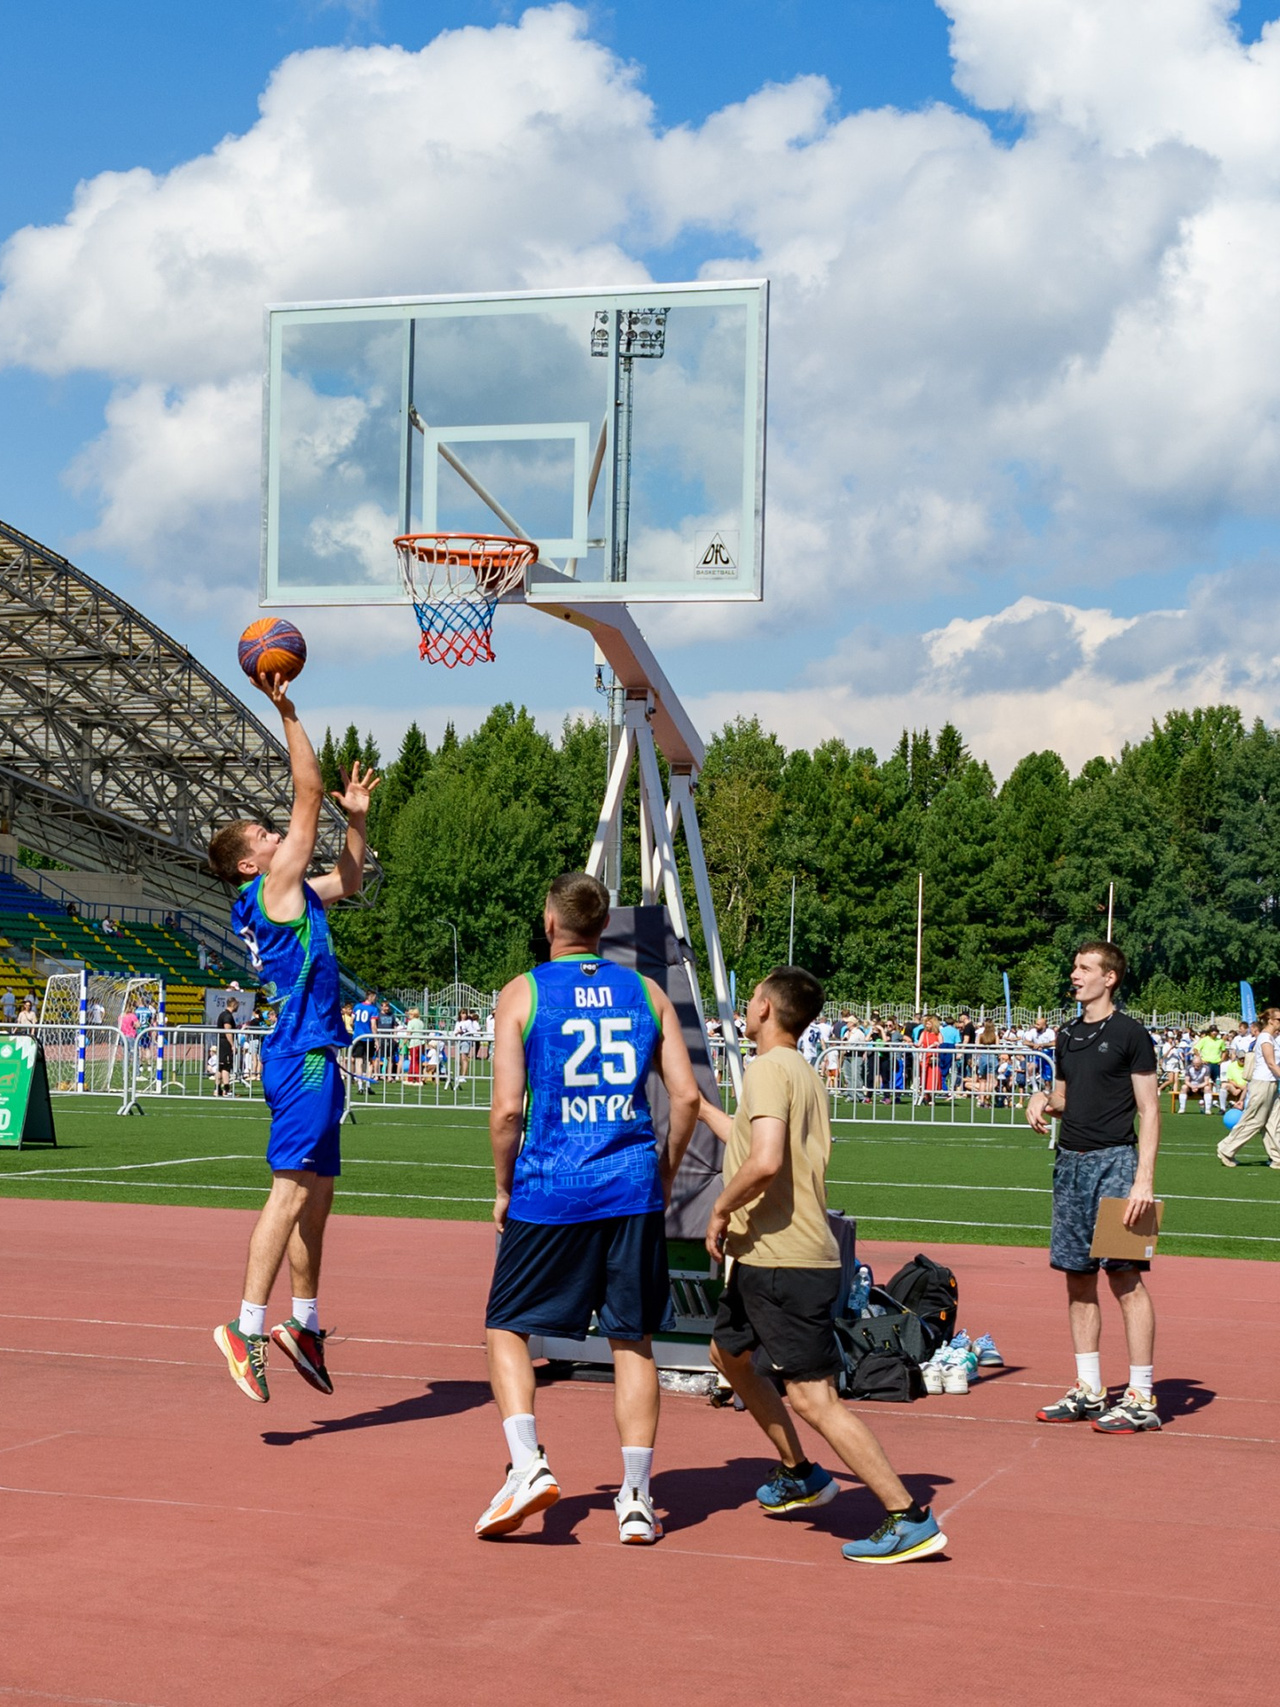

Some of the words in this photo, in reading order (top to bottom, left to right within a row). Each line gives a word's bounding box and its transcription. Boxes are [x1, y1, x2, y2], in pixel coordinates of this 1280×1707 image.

[702, 543, 730, 565] DFC
[574, 986, 613, 1008] ВАЛ
[355, 1009, 369, 1023] 10
[561, 1017, 637, 1087] 25
